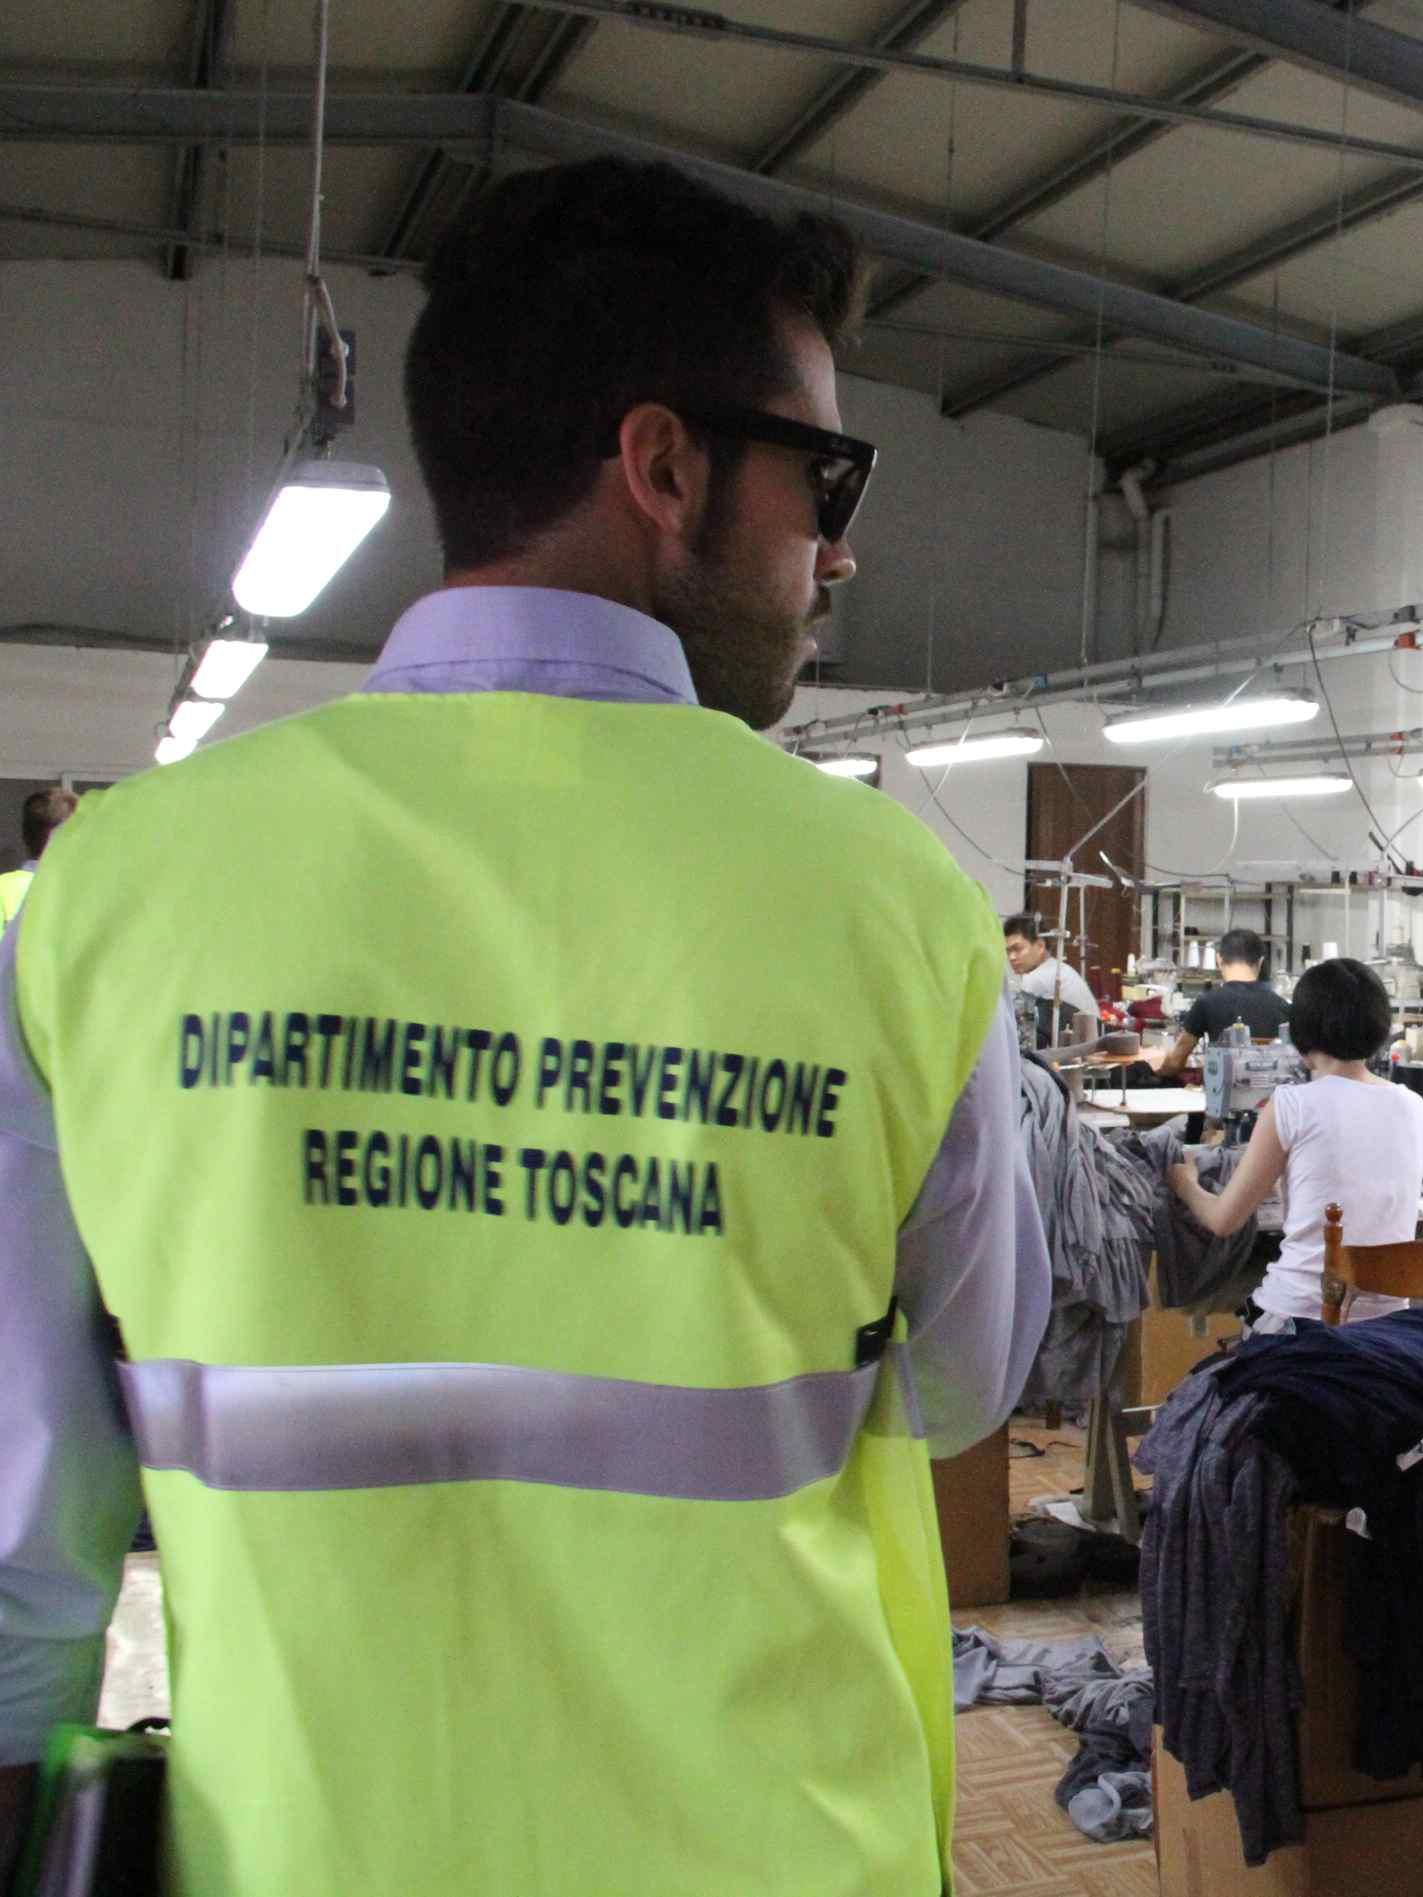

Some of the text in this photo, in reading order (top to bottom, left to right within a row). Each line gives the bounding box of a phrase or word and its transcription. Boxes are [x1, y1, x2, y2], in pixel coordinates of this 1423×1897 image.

[180, 1010, 849, 1139] DIPARTIMENTO PREVENZIONE
[302, 1127, 726, 1237] REGIONE TOSCANA
